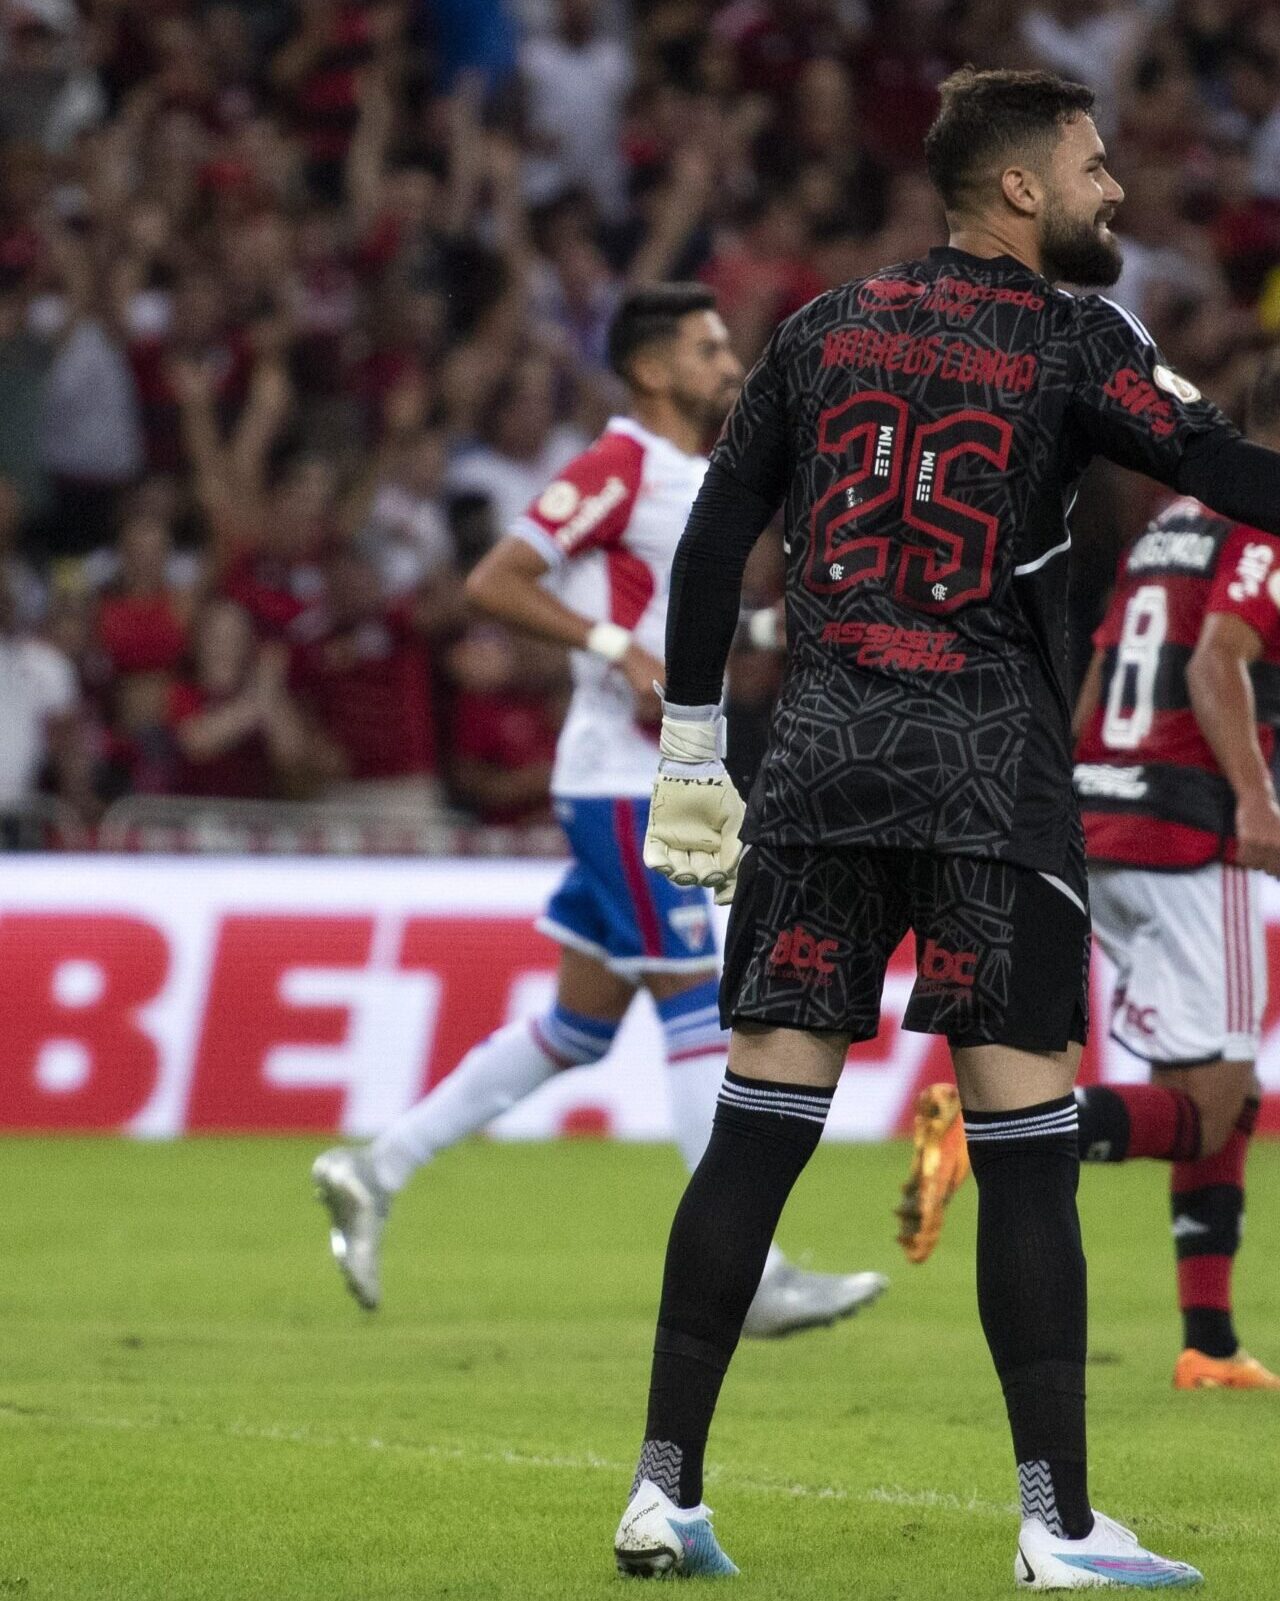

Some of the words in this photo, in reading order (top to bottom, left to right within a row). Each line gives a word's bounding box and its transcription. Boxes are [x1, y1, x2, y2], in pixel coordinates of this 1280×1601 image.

[922, 293, 977, 319] livre
[935, 275, 1045, 312] mercado
[821, 328, 942, 376] MATHEUS
[939, 341, 1038, 393] CUNHA
[876, 425, 894, 457] TIM
[918, 450, 936, 483] TIM
[803, 388, 1014, 616] 25
[819, 621, 959, 651] ASSIST
[856, 643, 967, 673] CARD
[1102, 584, 1168, 750] 8
[770, 922, 839, 973] abc
